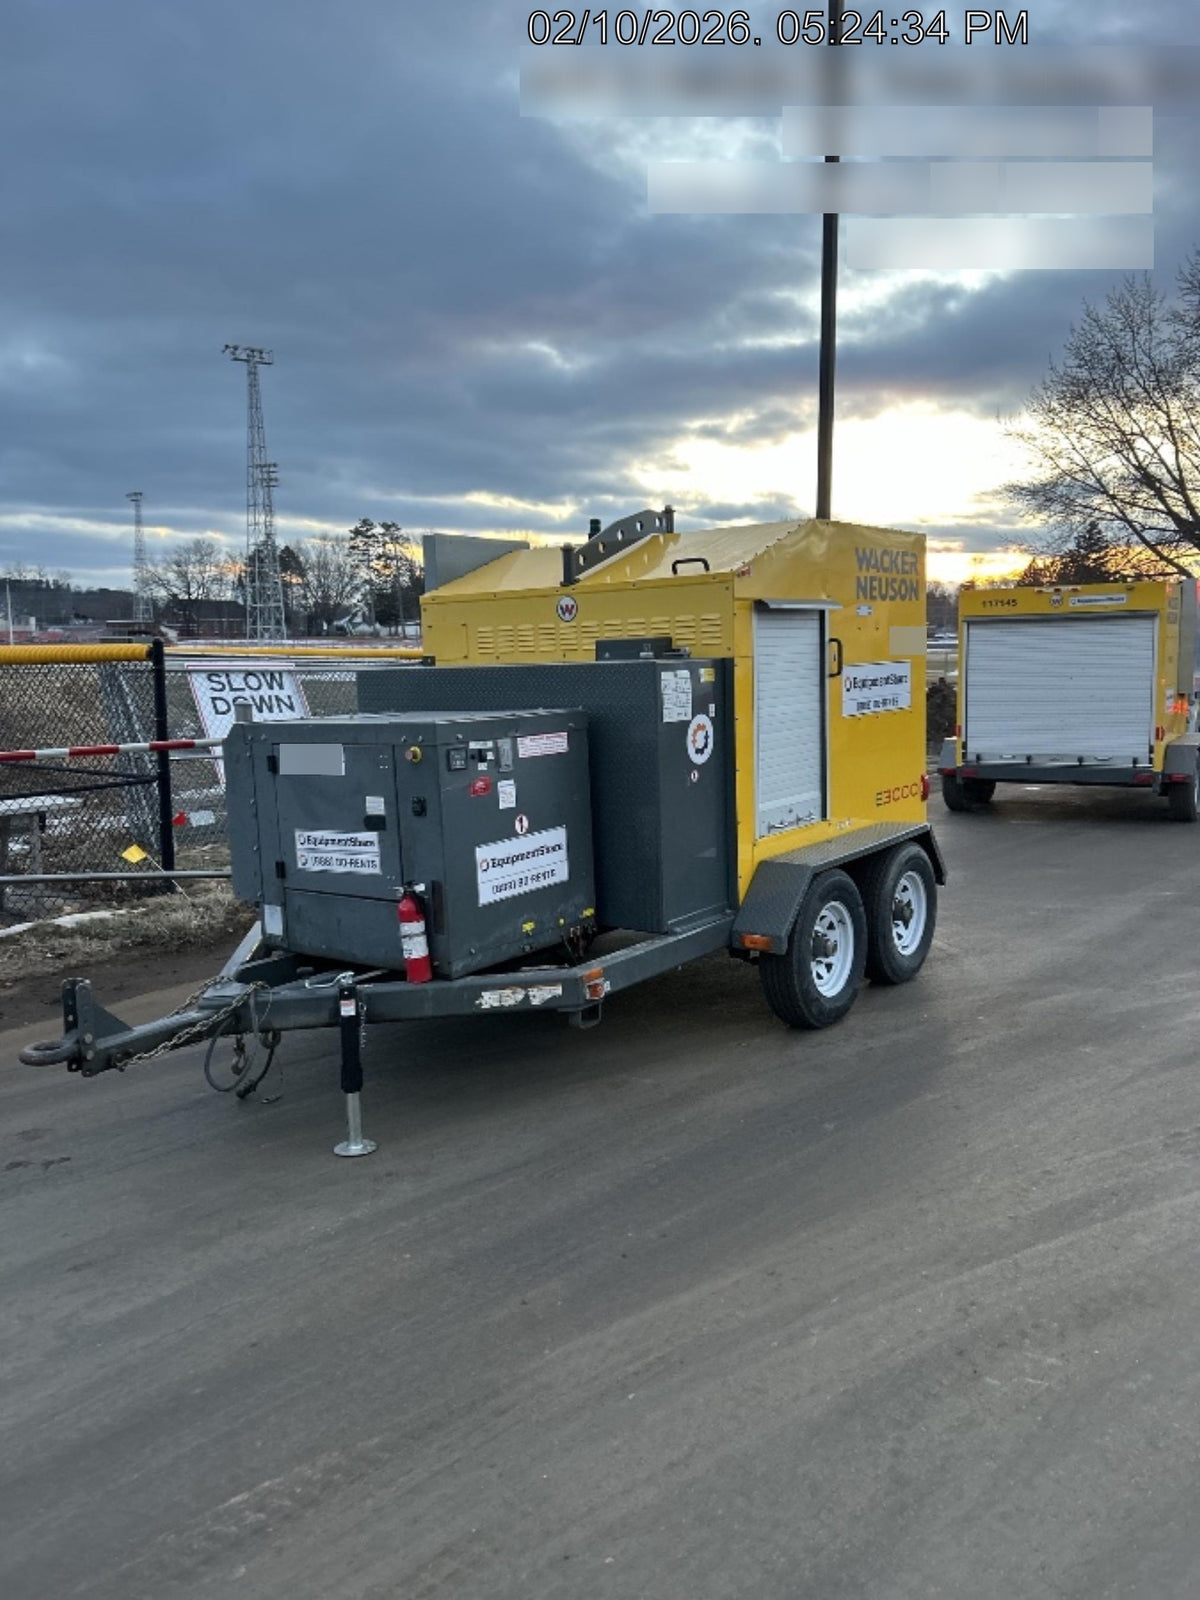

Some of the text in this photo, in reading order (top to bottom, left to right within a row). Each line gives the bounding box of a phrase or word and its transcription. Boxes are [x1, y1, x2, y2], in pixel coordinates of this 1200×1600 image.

[854, 546, 918, 575] WACKER
[855, 575, 920, 602] NEUSON
[207, 672, 285, 693] SLOW
[210, 695, 296, 716] DWN
